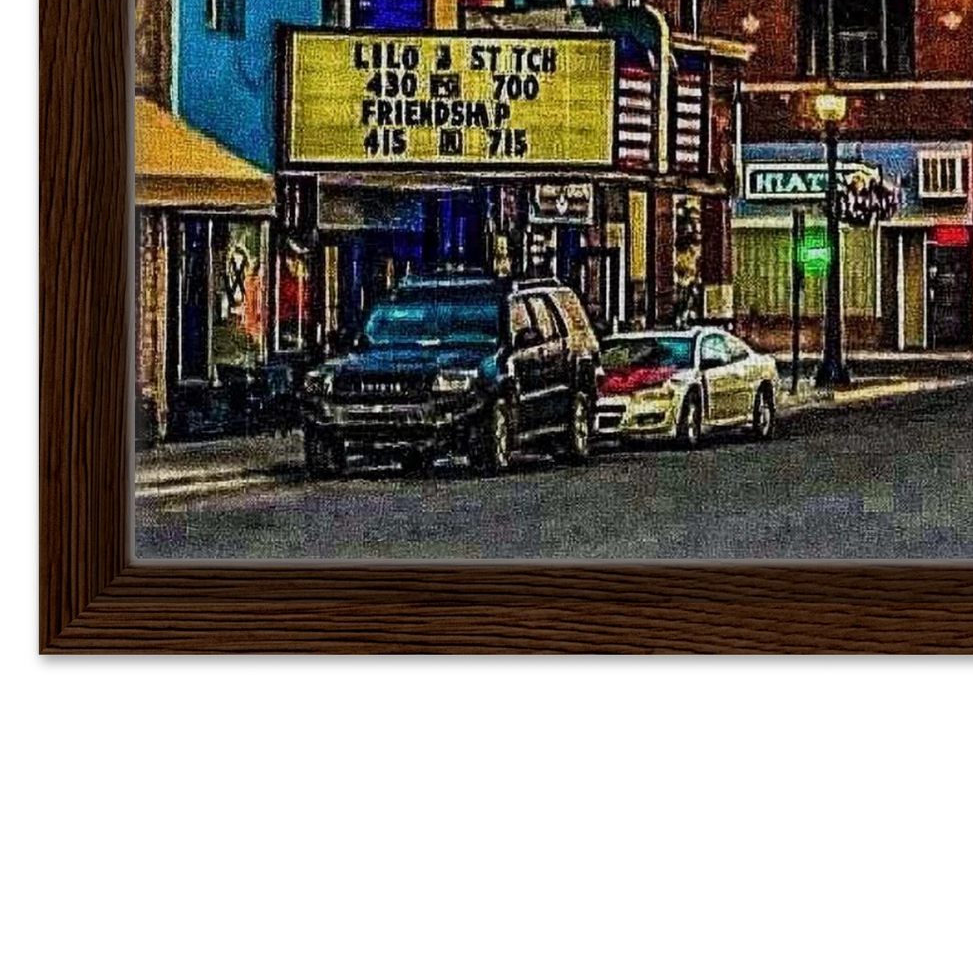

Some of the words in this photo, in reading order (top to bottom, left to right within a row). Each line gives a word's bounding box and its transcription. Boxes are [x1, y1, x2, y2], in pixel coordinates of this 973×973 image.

[355, 41, 419, 70] LILO
[366, 71, 417, 98] 430
[492, 74, 539, 100] 700
[363, 128, 408, 157] 415
[487, 128, 528, 158] 715
